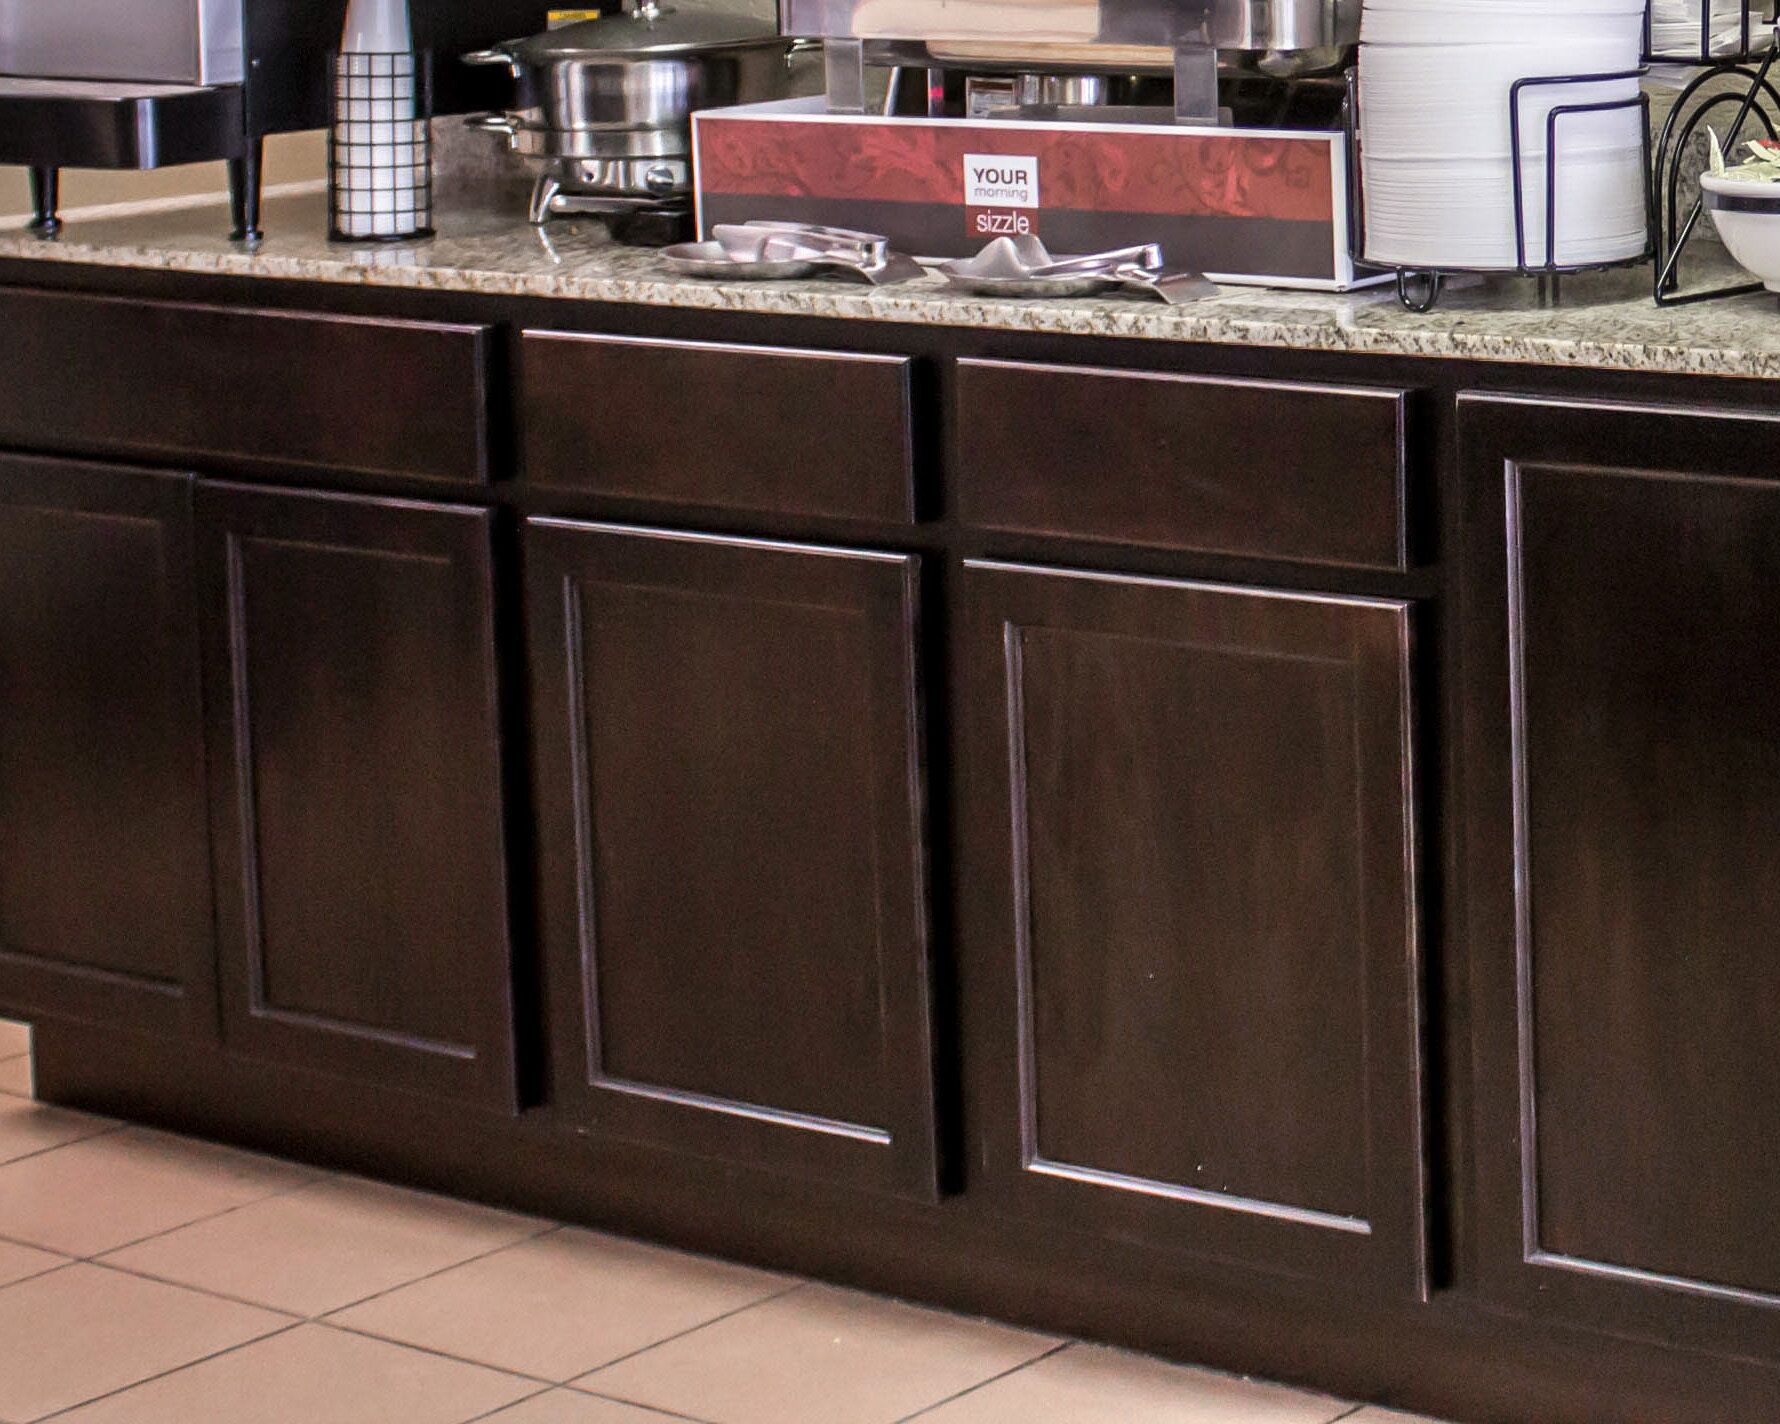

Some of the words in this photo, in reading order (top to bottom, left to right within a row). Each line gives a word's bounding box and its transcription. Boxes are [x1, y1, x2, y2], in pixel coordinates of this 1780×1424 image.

[973, 168, 1028, 185] YOUR
[974, 187, 1028, 203] morning
[976, 209, 1030, 234] sizzle
